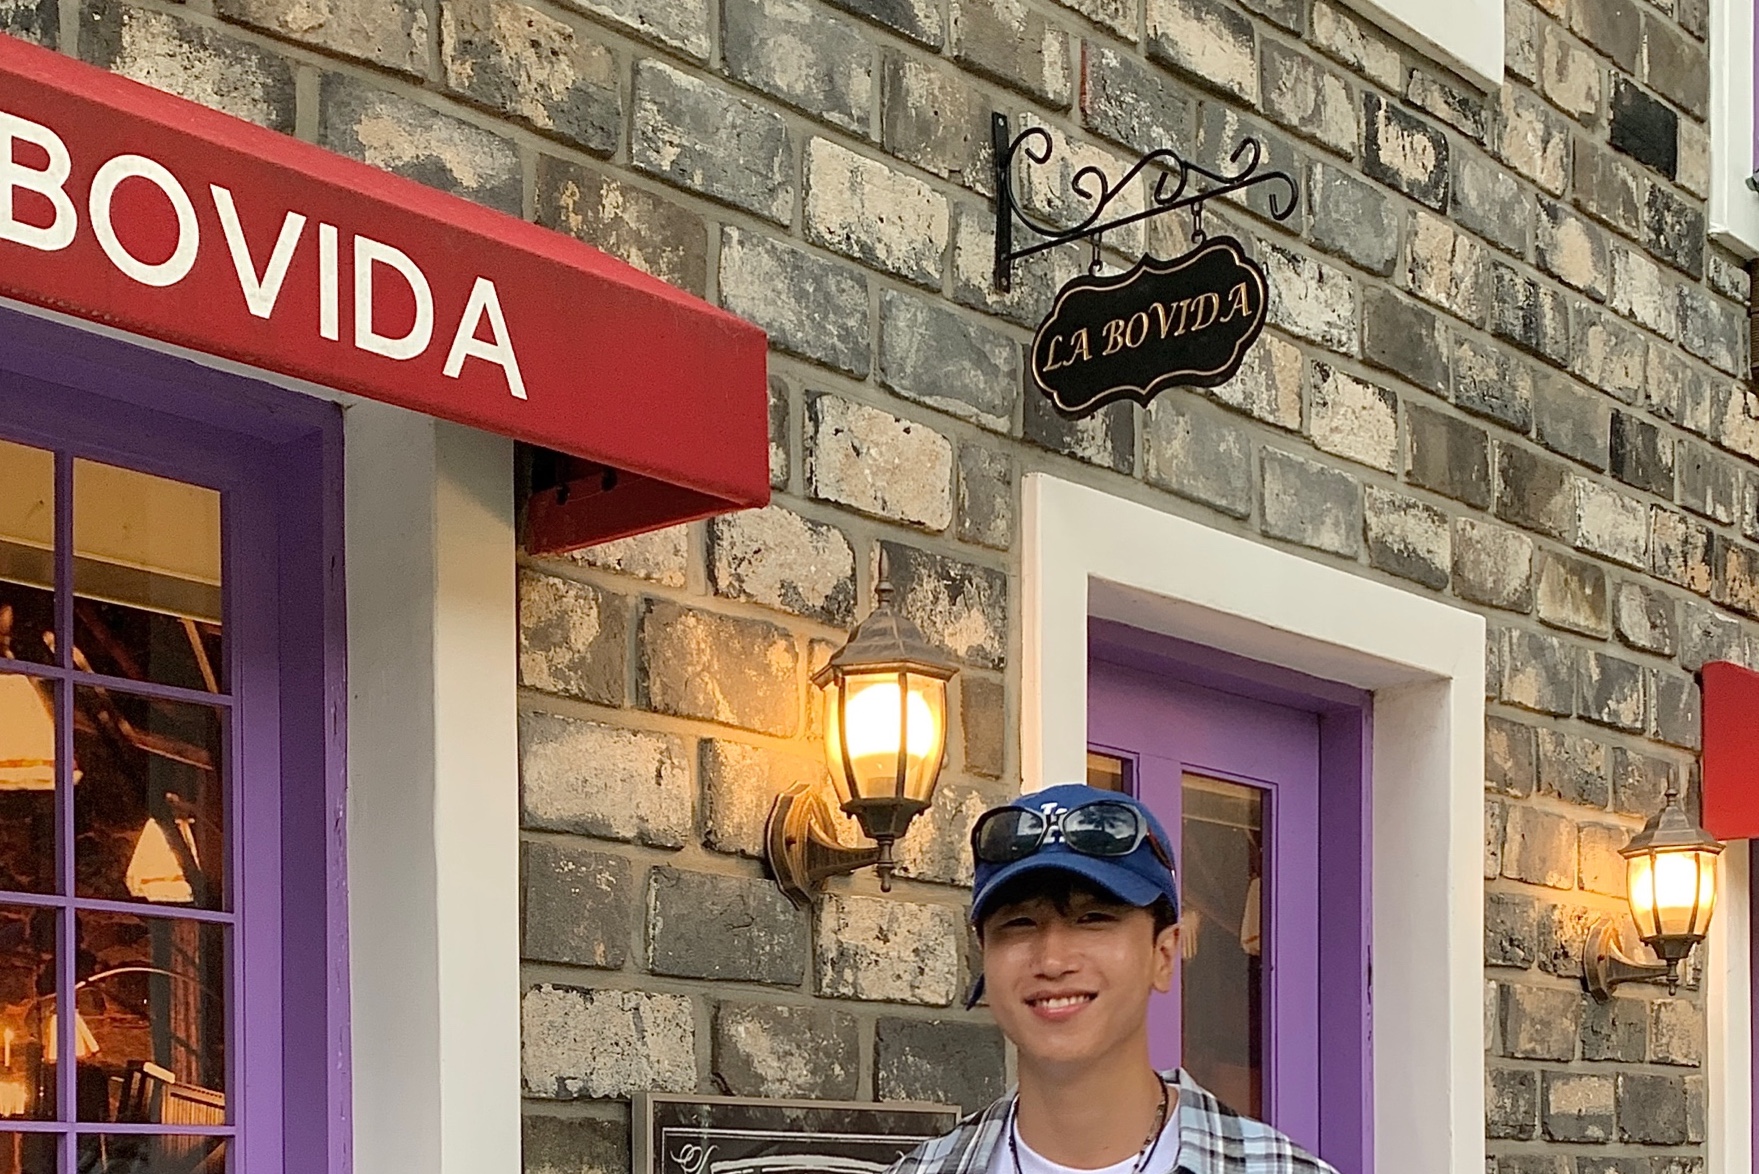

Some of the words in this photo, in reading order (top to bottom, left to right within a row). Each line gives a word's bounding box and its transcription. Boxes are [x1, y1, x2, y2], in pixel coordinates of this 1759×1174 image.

[0, 111, 528, 401] BOVIDA
[1042, 327, 1092, 372] LA
[1102, 282, 1252, 356] BOVIDA
